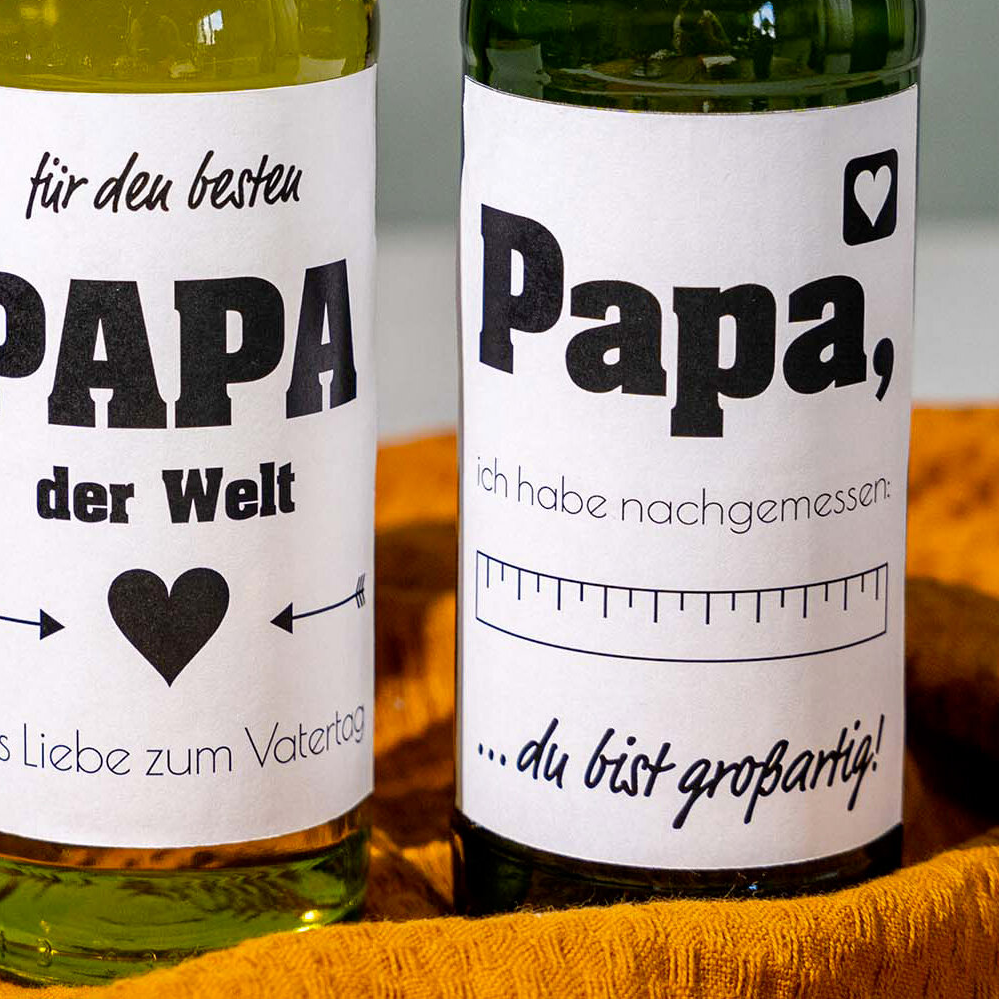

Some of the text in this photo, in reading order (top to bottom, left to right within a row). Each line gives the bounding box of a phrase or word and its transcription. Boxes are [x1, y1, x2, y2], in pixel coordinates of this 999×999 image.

[26, 150, 302, 219] für den besten
[479, 203, 895, 437] Papa,
[37, 462, 295, 524] der Welt
[478, 457, 890, 534] ich habe nachgemessen:
[24, 723, 130, 775] Liebe
[146, 746, 231, 775] zum
[245, 706, 364, 766] Vatertag
[584, 728, 673, 797] bist
[670, 714, 885, 829] großartig!
